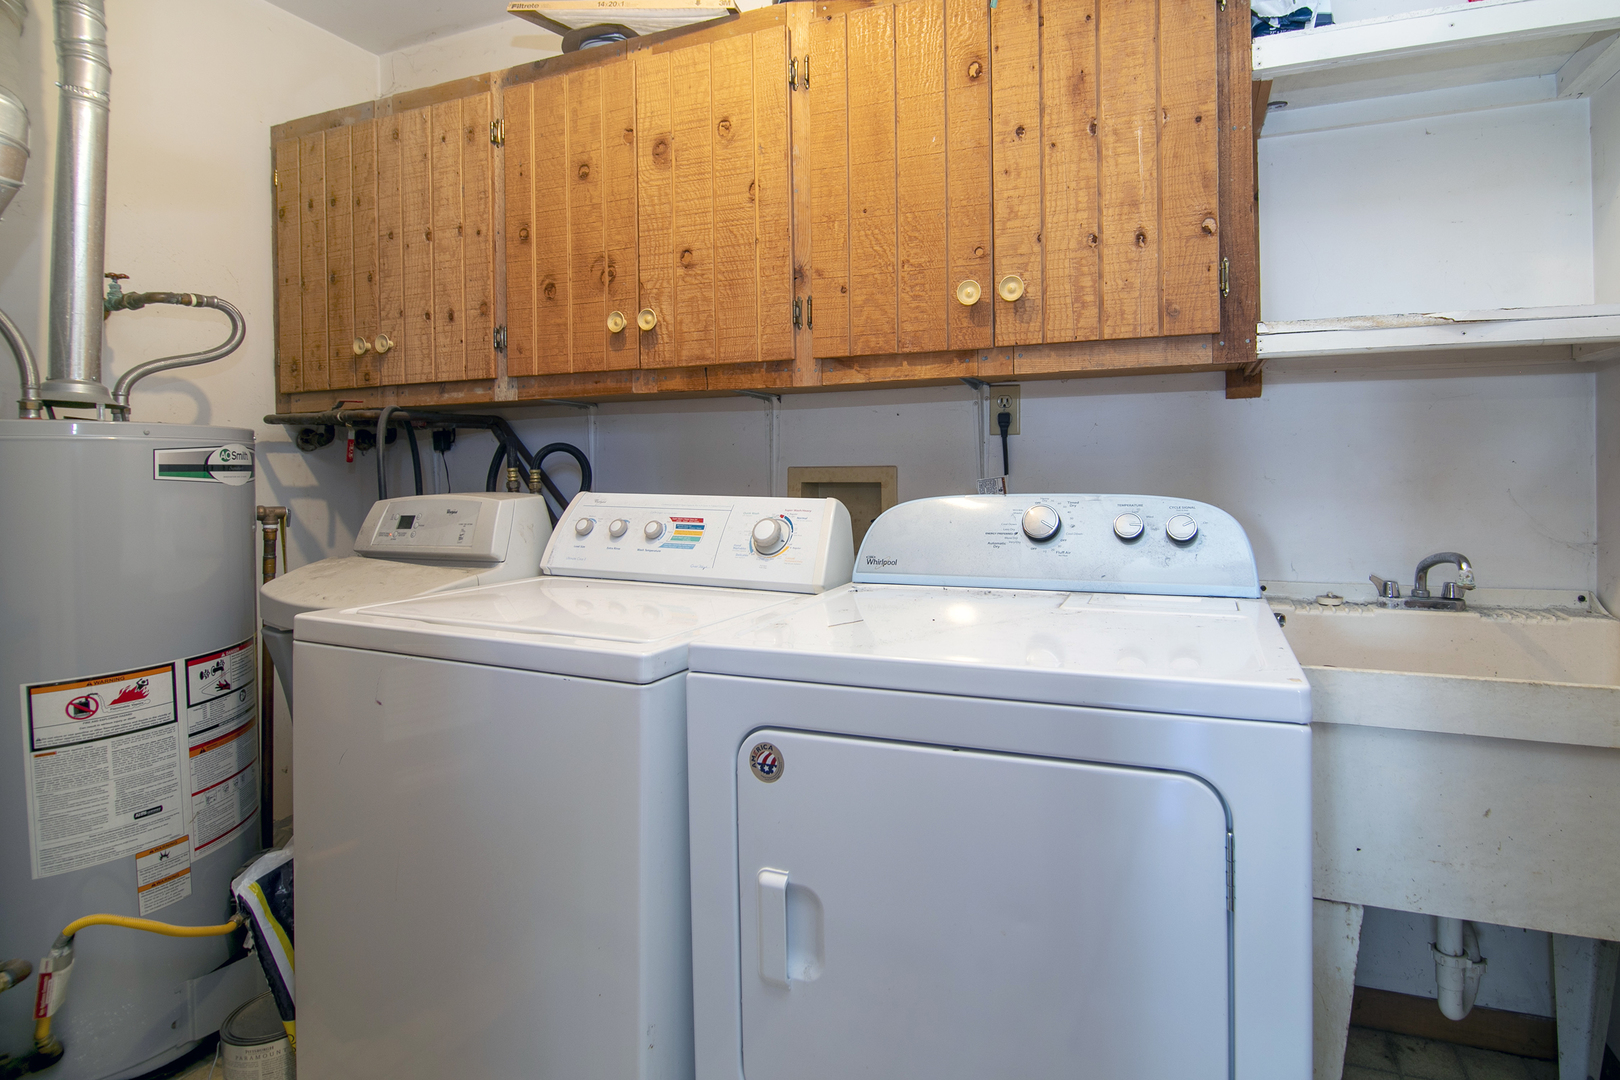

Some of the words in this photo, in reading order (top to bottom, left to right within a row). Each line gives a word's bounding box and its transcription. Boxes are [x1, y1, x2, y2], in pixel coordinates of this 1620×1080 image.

[866, 558, 898, 567] Whirlpool
[93, 676, 126, 686] WARNING
[751, 744, 773, 768] AMERICA
[235, 1048, 288, 1060] PARAMOUNT
